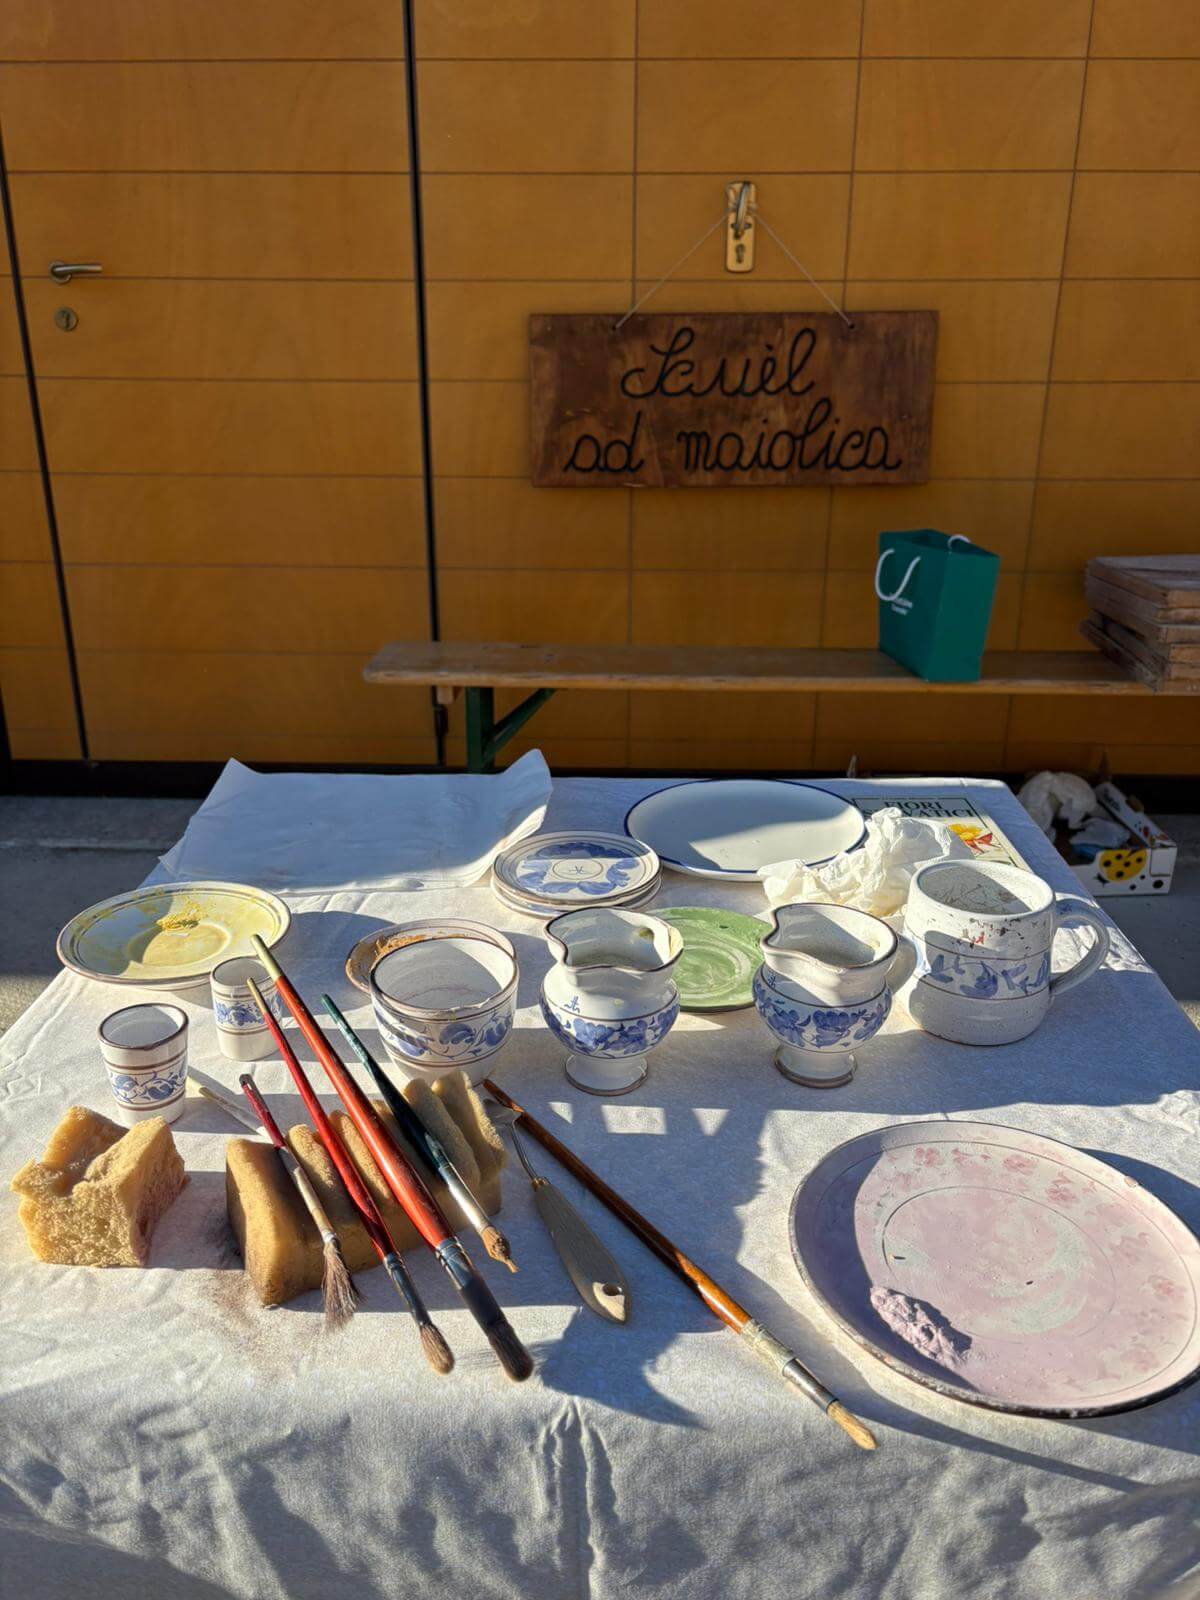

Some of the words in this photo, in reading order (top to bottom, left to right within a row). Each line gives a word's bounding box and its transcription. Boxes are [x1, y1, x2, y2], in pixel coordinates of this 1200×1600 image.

[563, 410, 645, 473] ad
[676, 397, 903, 472] maiolica
[884, 800, 943, 810] FIORI
[863, 808, 975, 818] SVATICI
